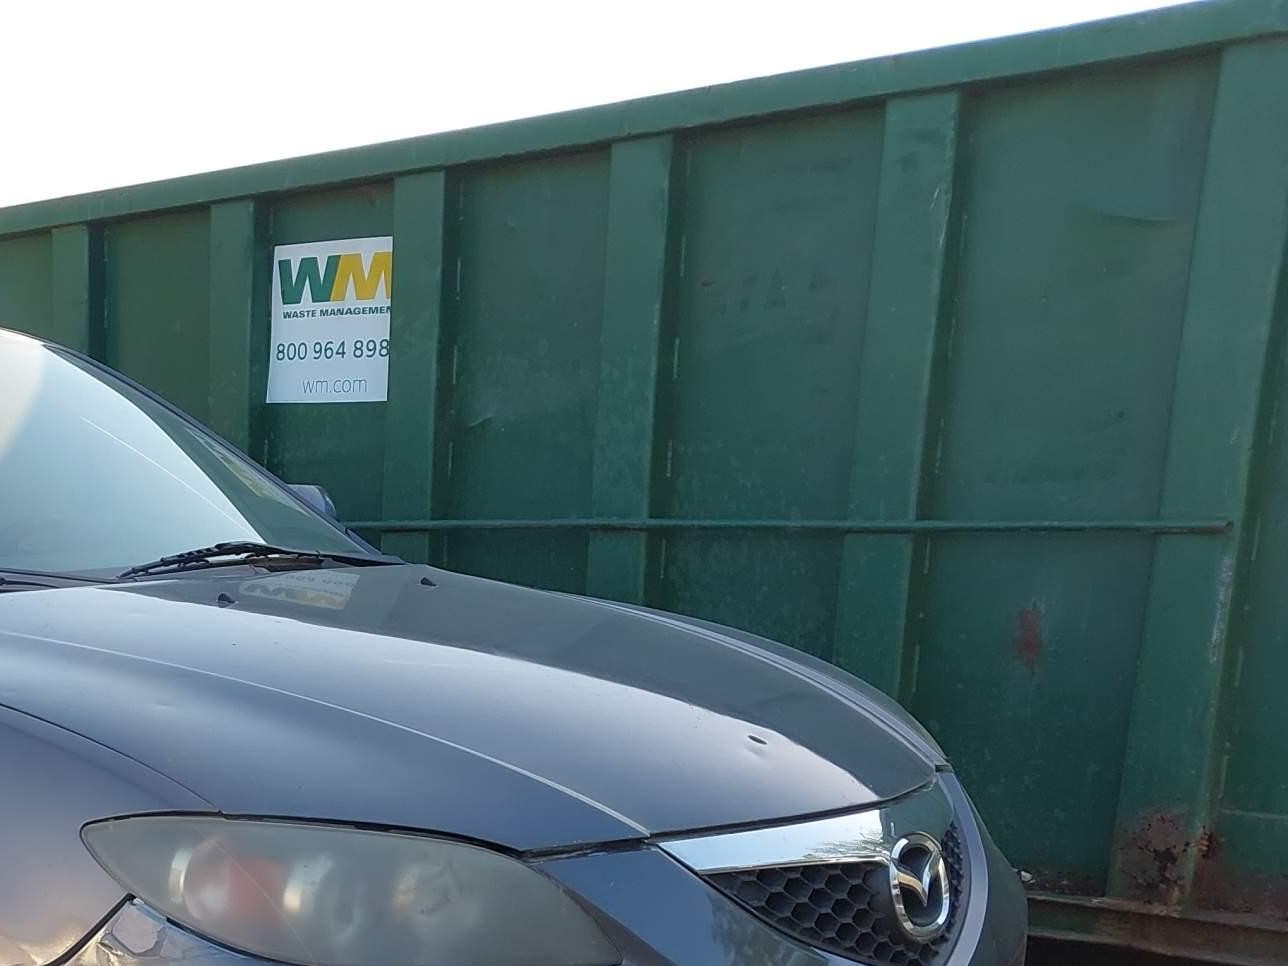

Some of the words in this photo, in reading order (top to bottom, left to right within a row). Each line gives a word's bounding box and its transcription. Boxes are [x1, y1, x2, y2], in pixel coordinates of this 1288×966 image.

[278, 251, 392, 304] WM
[283, 309, 317, 319] WASTE
[276, 342, 307, 361] 800
[312, 340, 346, 360] 964
[352, 338, 390, 358] 898
[302, 378, 368, 394] wm.com
